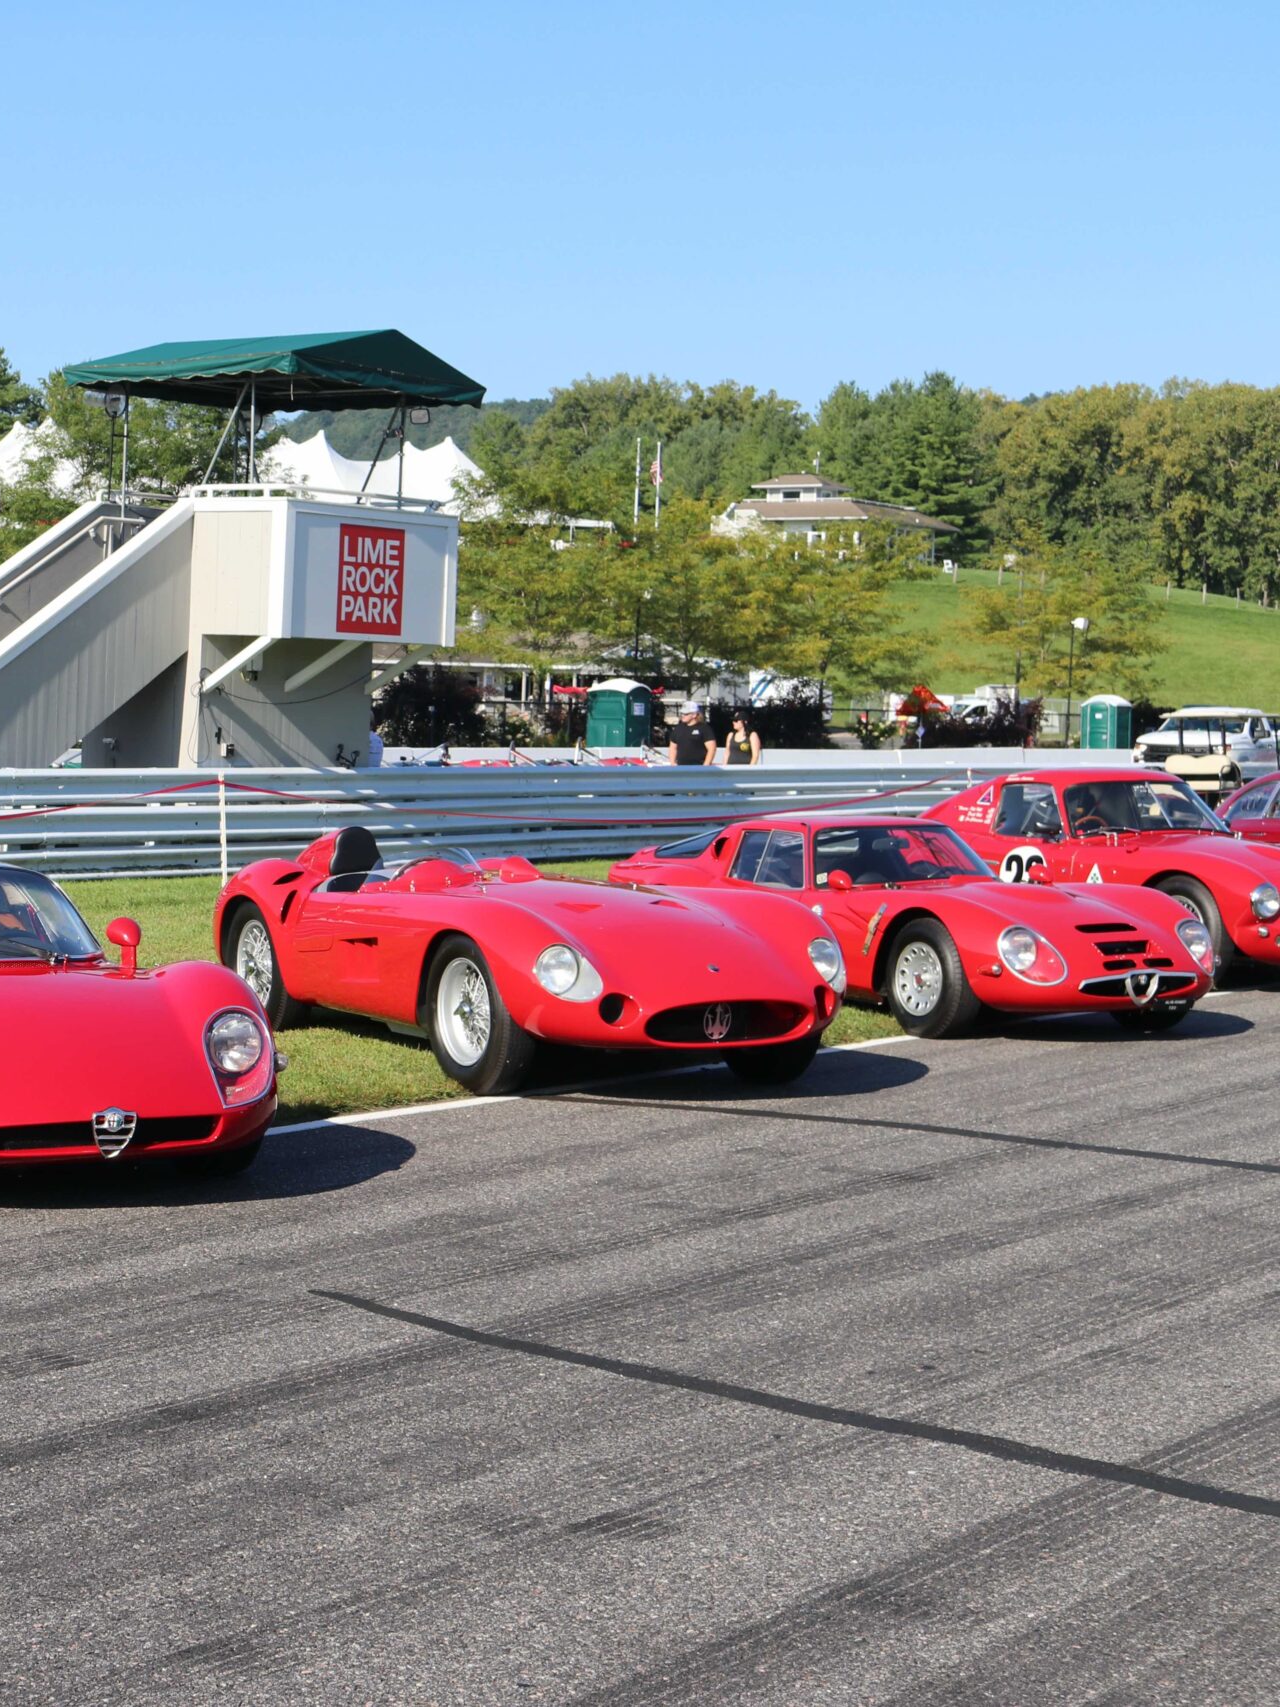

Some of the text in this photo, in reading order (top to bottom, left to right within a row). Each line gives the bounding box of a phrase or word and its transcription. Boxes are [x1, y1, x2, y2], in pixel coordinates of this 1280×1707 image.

[343, 535, 400, 566] LIME
[341, 565, 399, 595] ROCK
[340, 595, 397, 624] PARK
